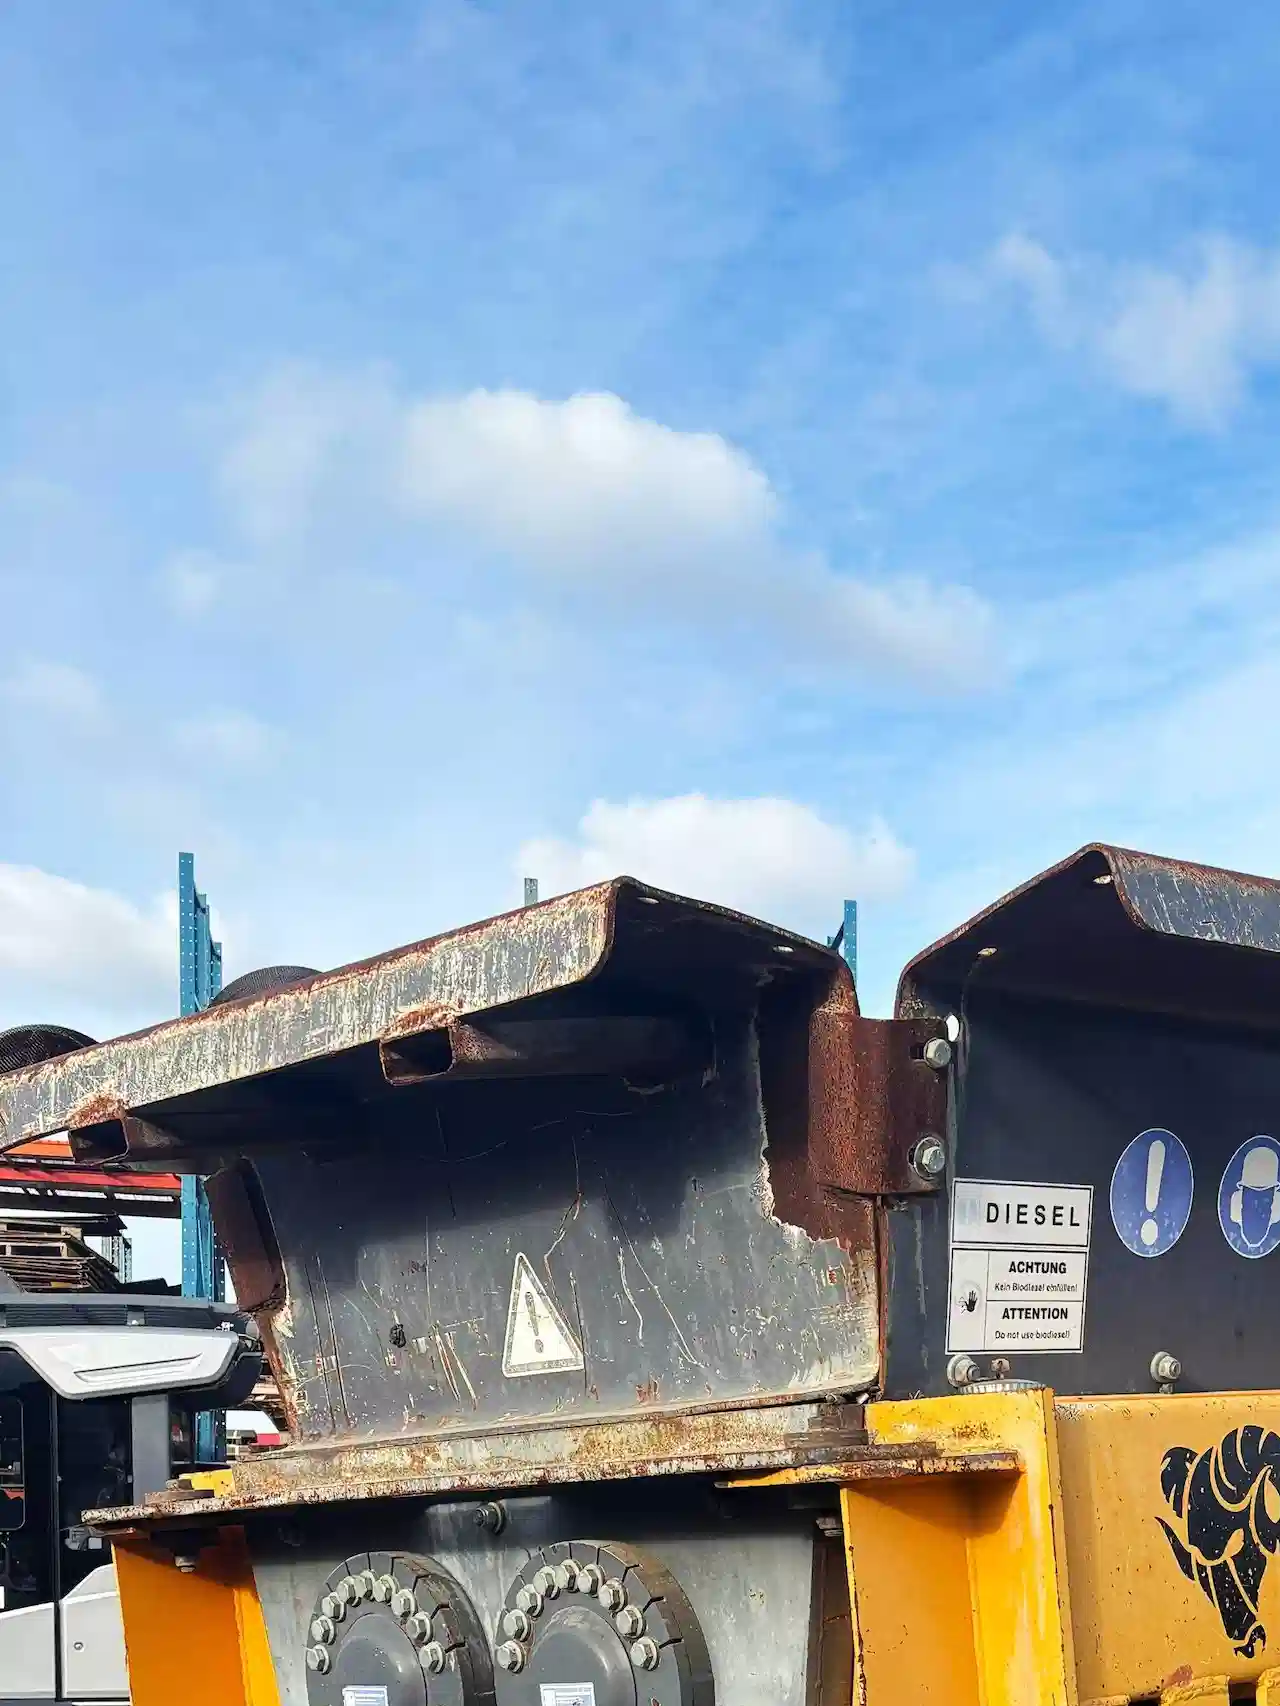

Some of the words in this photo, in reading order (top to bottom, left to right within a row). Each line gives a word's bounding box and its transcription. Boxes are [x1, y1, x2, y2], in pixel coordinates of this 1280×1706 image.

[986, 1202, 1080, 1227] DIESEL
[1008, 1261, 1067, 1274] ACHTUNG
[994, 1282, 1011, 1292] Kein
[1012, 1282, 1045, 1292] Biodiesel
[1002, 1307, 1068, 1320] ATTENTION
[994, 1330, 1006, 1339] Do
[1007, 1331, 1020, 1339] not
[1021, 1331, 1034, 1339] use
[1035, 1330, 1070, 1339] biodiesel!
